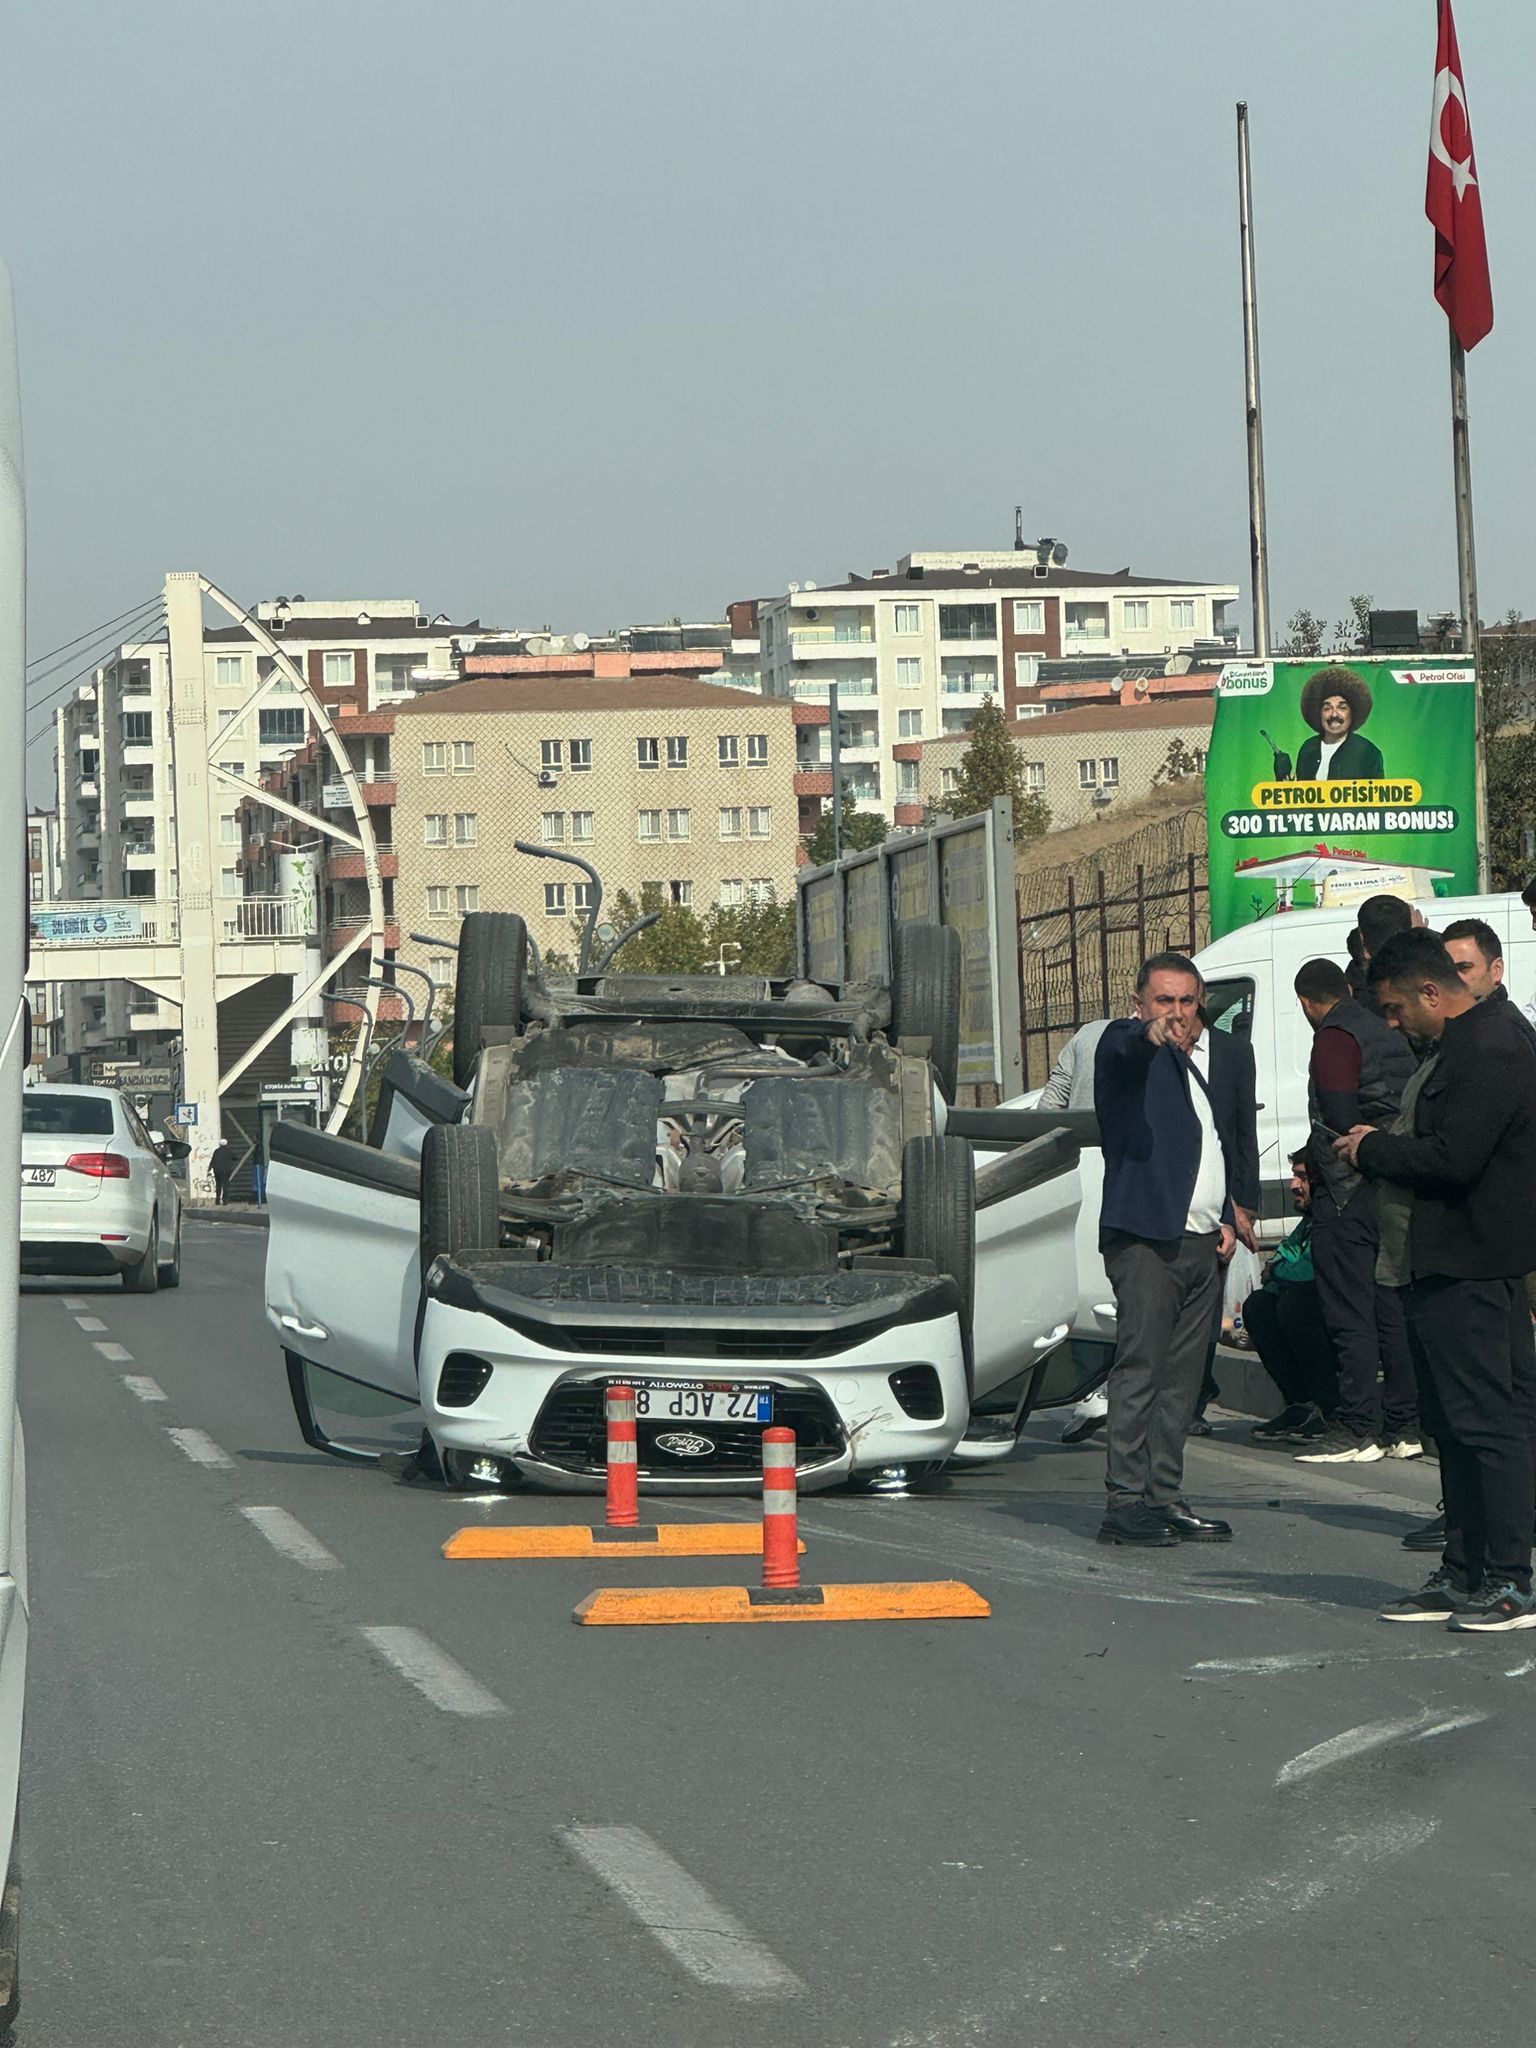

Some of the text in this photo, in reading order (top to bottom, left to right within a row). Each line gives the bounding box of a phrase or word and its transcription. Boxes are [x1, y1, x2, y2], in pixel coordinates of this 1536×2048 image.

[1226, 677, 1268, 690] bonus
[1420, 672, 1466, 681] Petrol Ofisi
[1260, 780, 1413, 806] PETROL OFİSİ'NDE
[1228, 810, 1454, 835] 300 TL'YE VARAN BONUS!
[31, 1168, 54, 1181] 487
[648, 1382, 704, 1390] OTOMOTİV
[636, 1389, 757, 1419] 72 ACP 8
[667, 1436, 704, 1453] Ford
